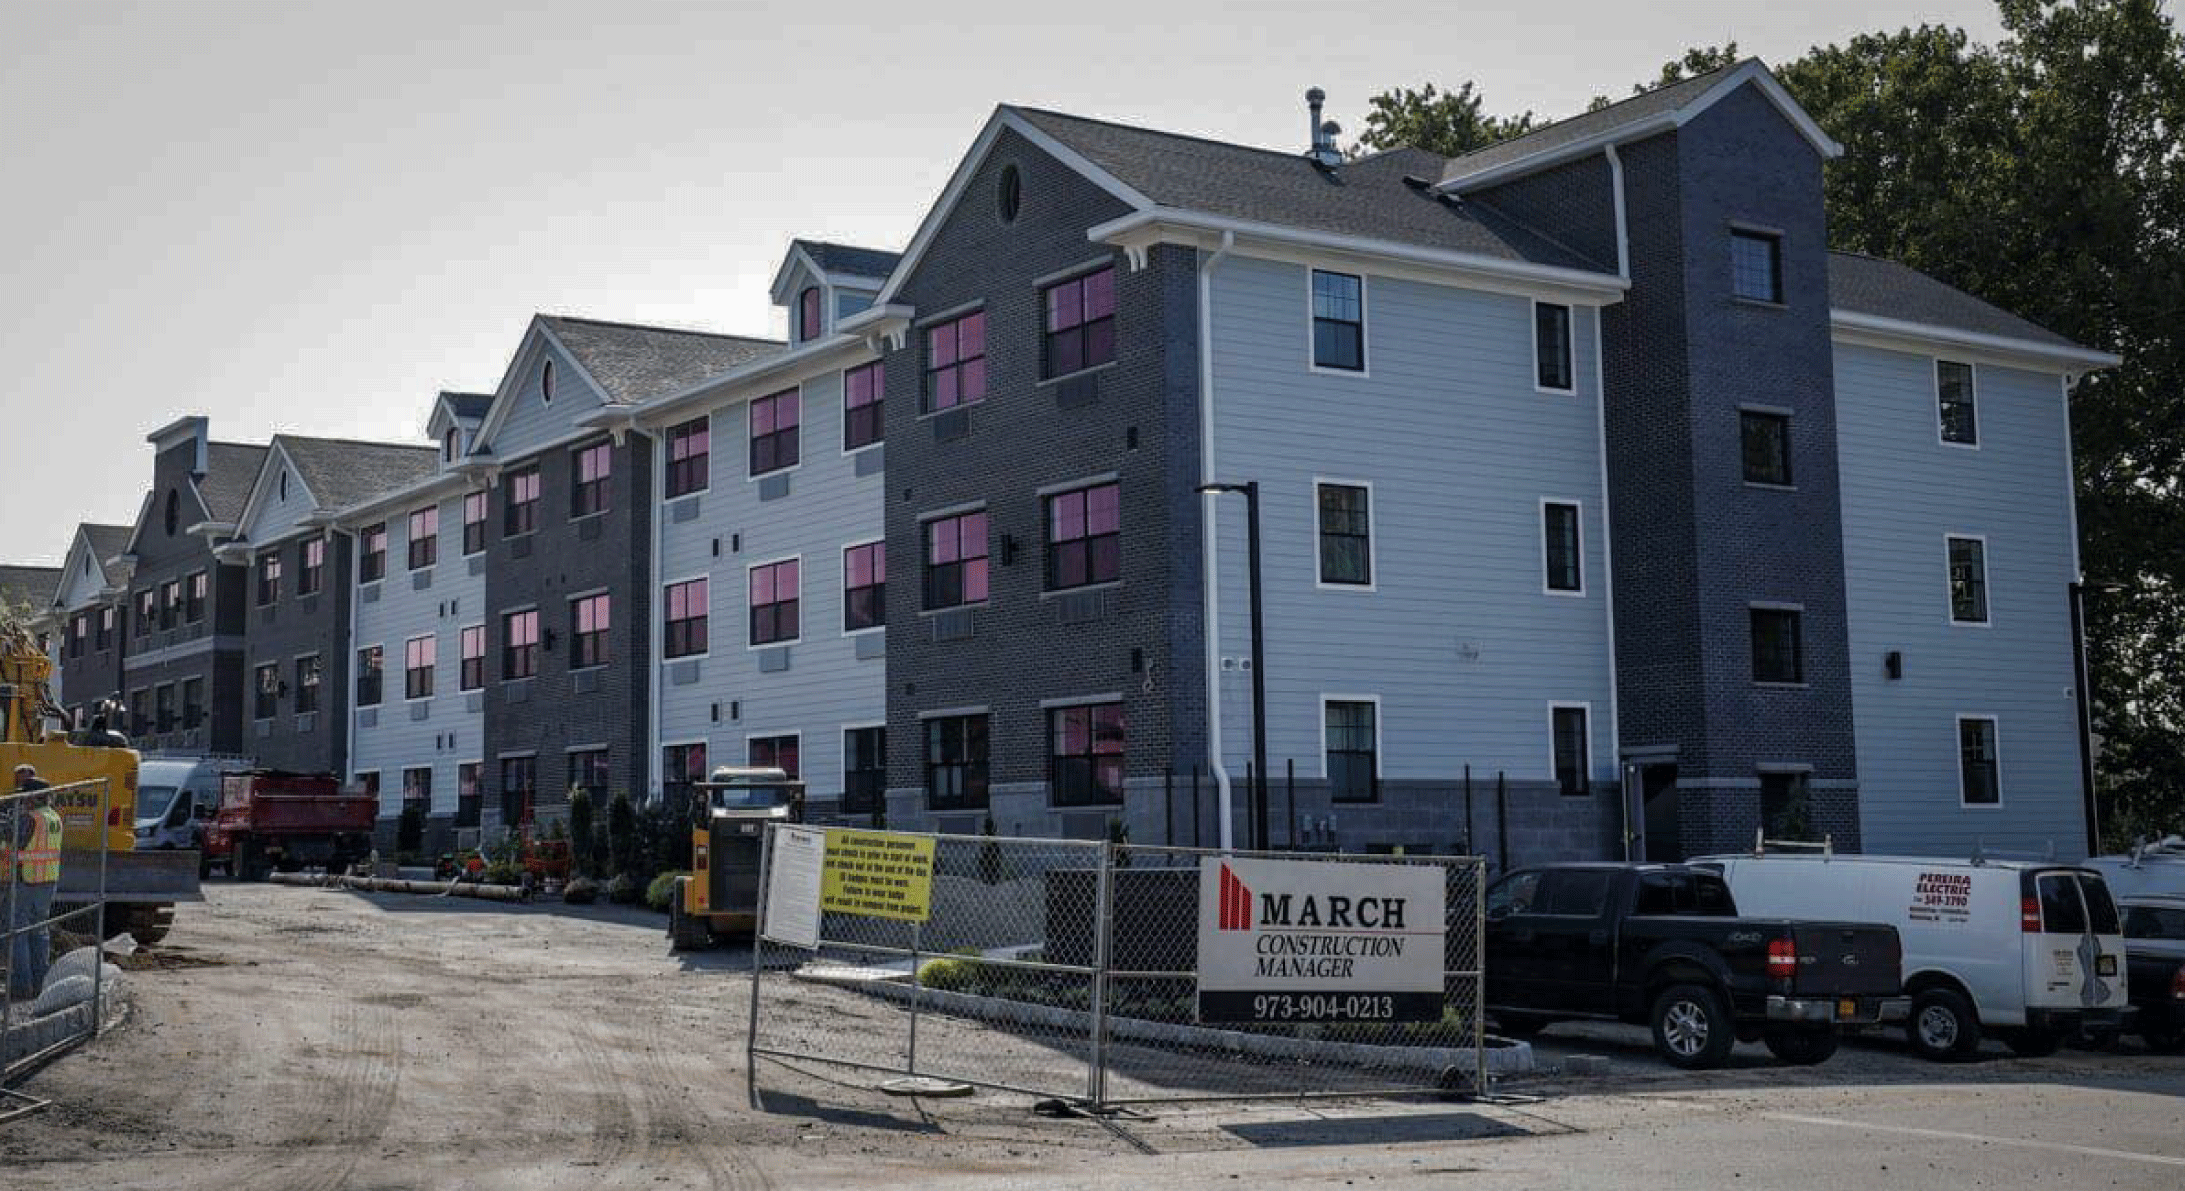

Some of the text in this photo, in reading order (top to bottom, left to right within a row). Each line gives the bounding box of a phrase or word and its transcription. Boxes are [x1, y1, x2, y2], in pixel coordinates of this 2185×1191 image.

[1916, 883, 1971, 895] ELECTRIC
[1919, 873, 1971, 884] PEREIRA
[1260, 893, 1406, 928] MARCH
[1256, 934, 1405, 957] CONSTRUCTION
[1254, 957, 1354, 978] MANAGER
[1254, 996, 1394, 1019] 973-904-0213
